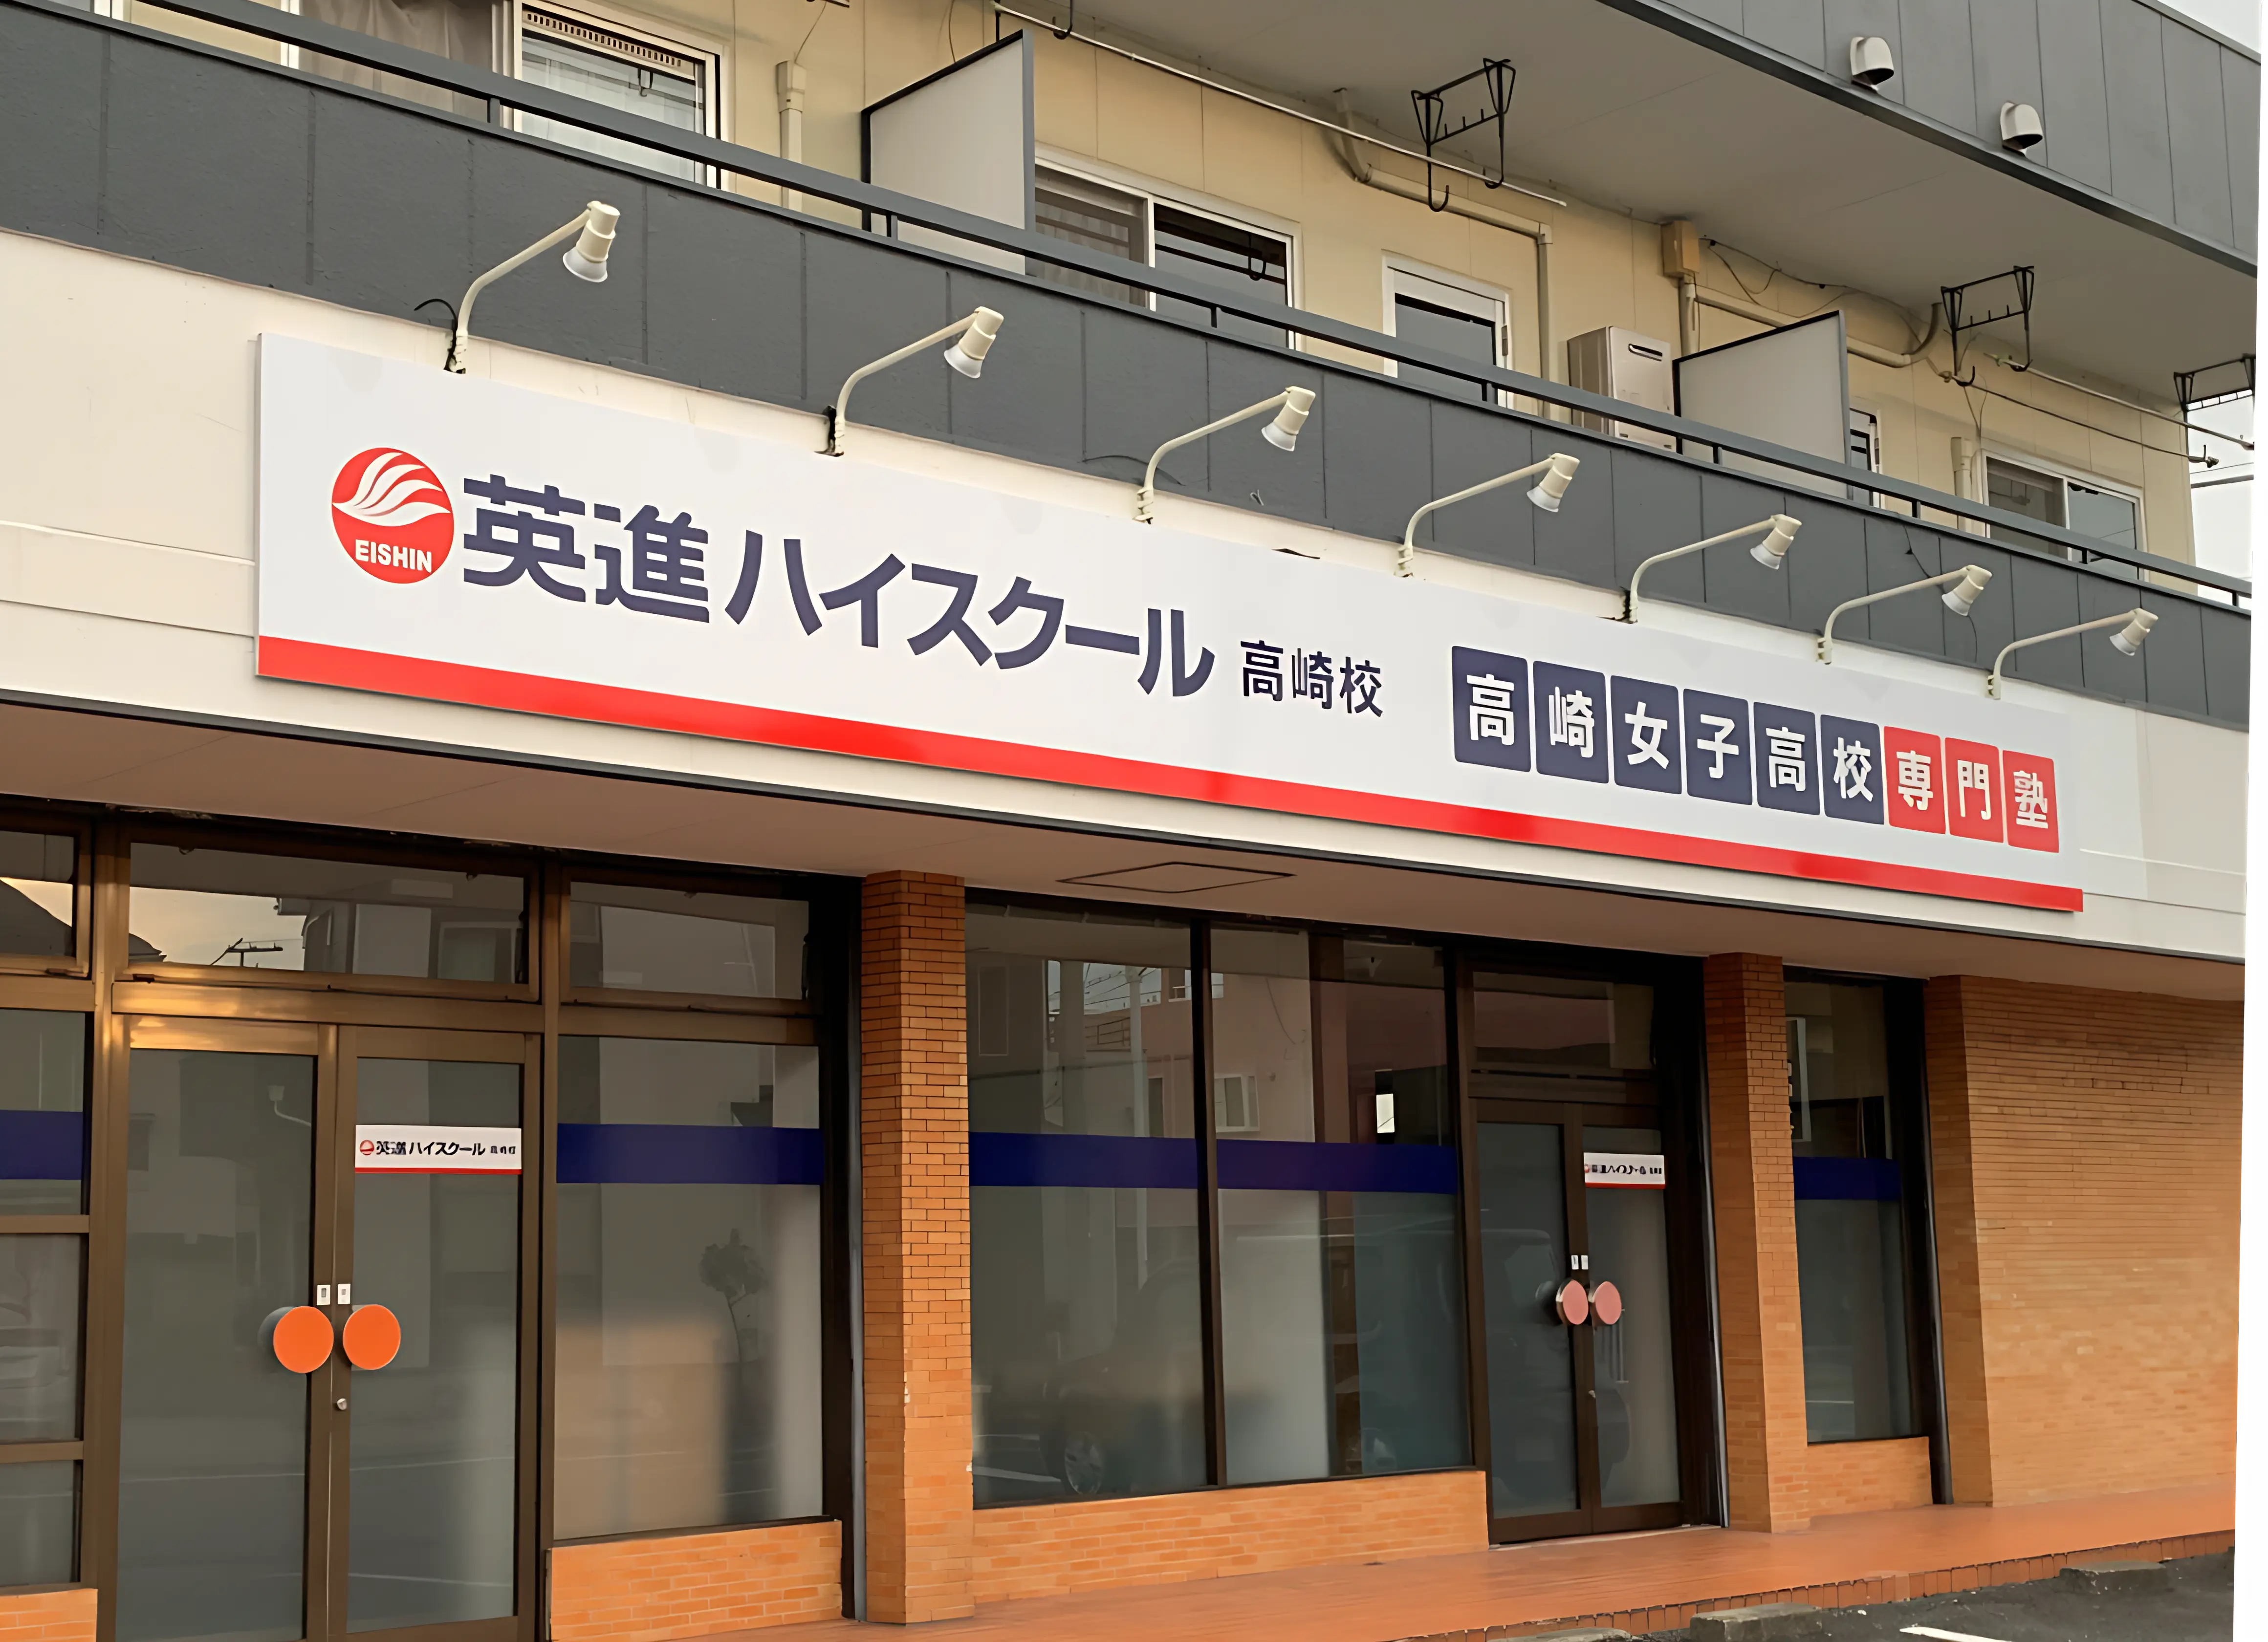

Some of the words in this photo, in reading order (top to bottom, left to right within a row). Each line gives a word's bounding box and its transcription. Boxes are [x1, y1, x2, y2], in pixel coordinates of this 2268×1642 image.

[355, 539, 432, 573] EISHIN
[463, 474, 1215, 697] 英進ハイスクール
[1240, 640, 1383, 717] 高崎校
[1466, 674, 2049, 829] 高崎女子高校専門塾
